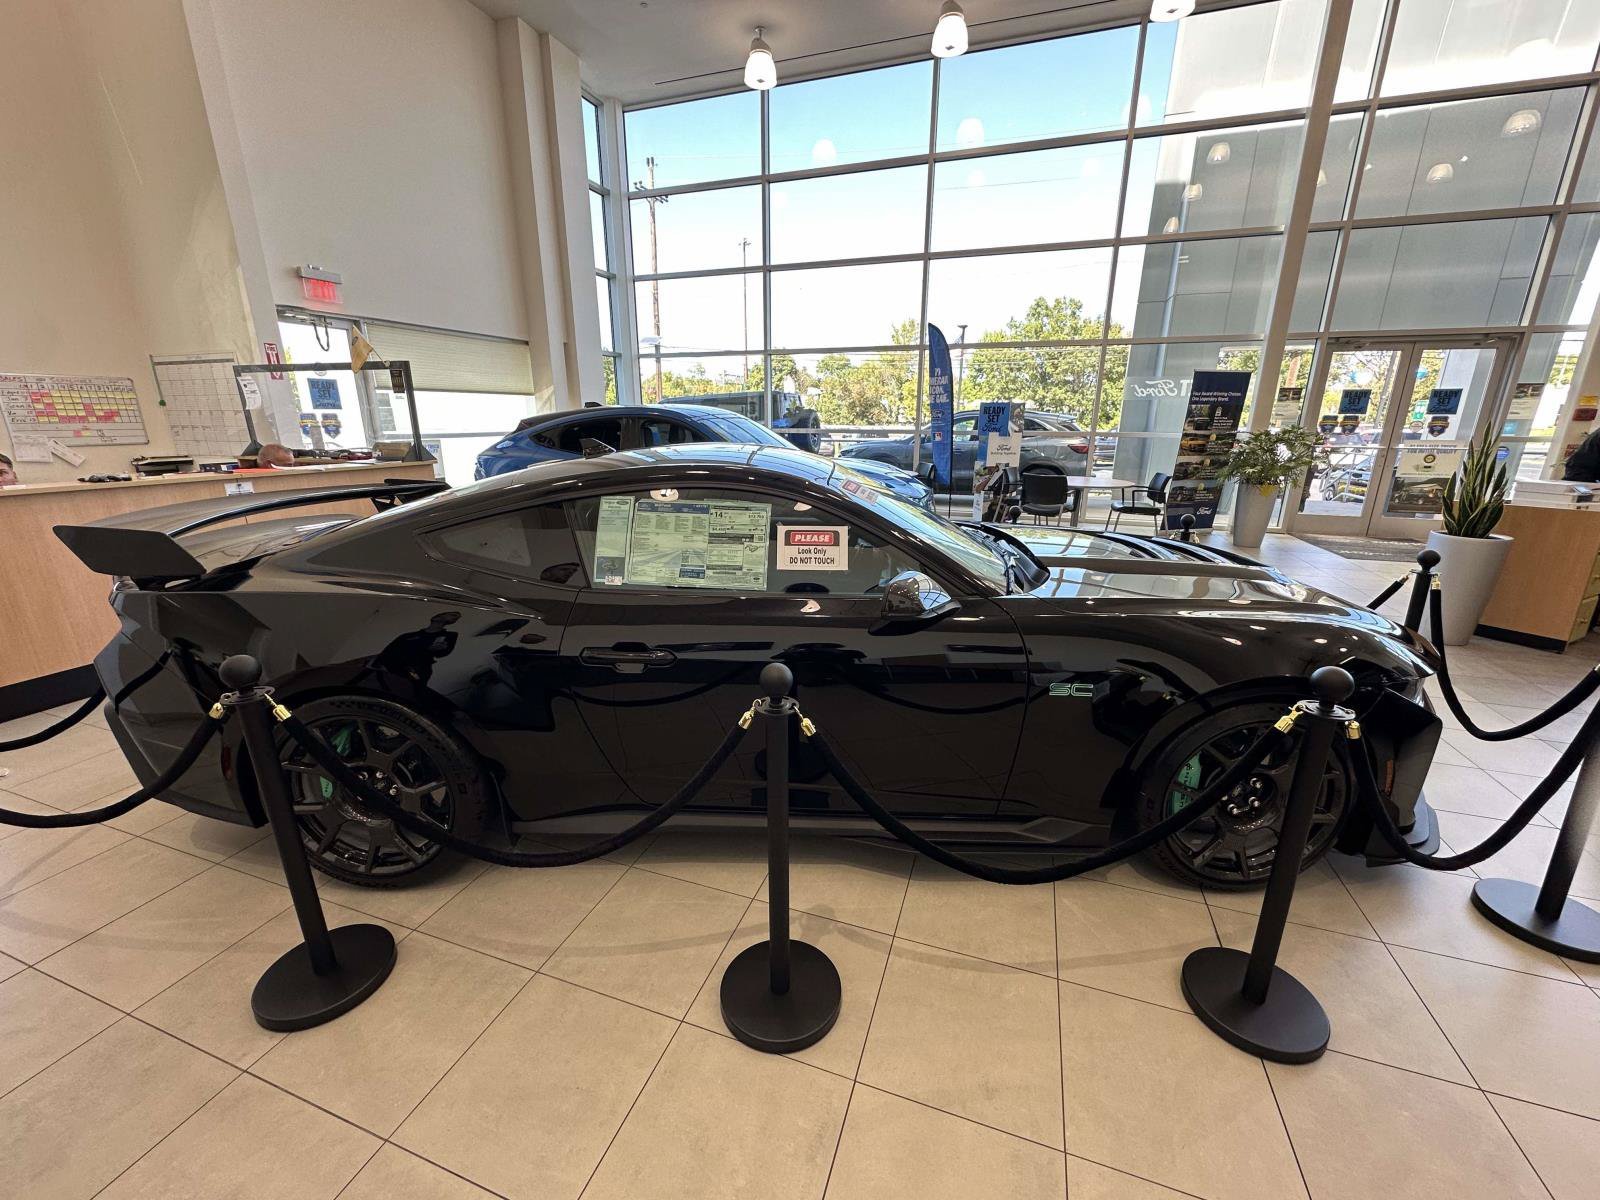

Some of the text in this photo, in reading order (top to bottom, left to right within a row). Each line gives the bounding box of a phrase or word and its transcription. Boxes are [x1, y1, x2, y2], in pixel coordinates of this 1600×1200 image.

[983, 406, 1006, 415] READY
[987, 415, 1000, 423] SET
[1196, 506, 1213, 515] Ford
[794, 534, 830, 543] PLEASE
[798, 547, 827, 556] Look Only
[814, 557, 835, 565] TOUCH
